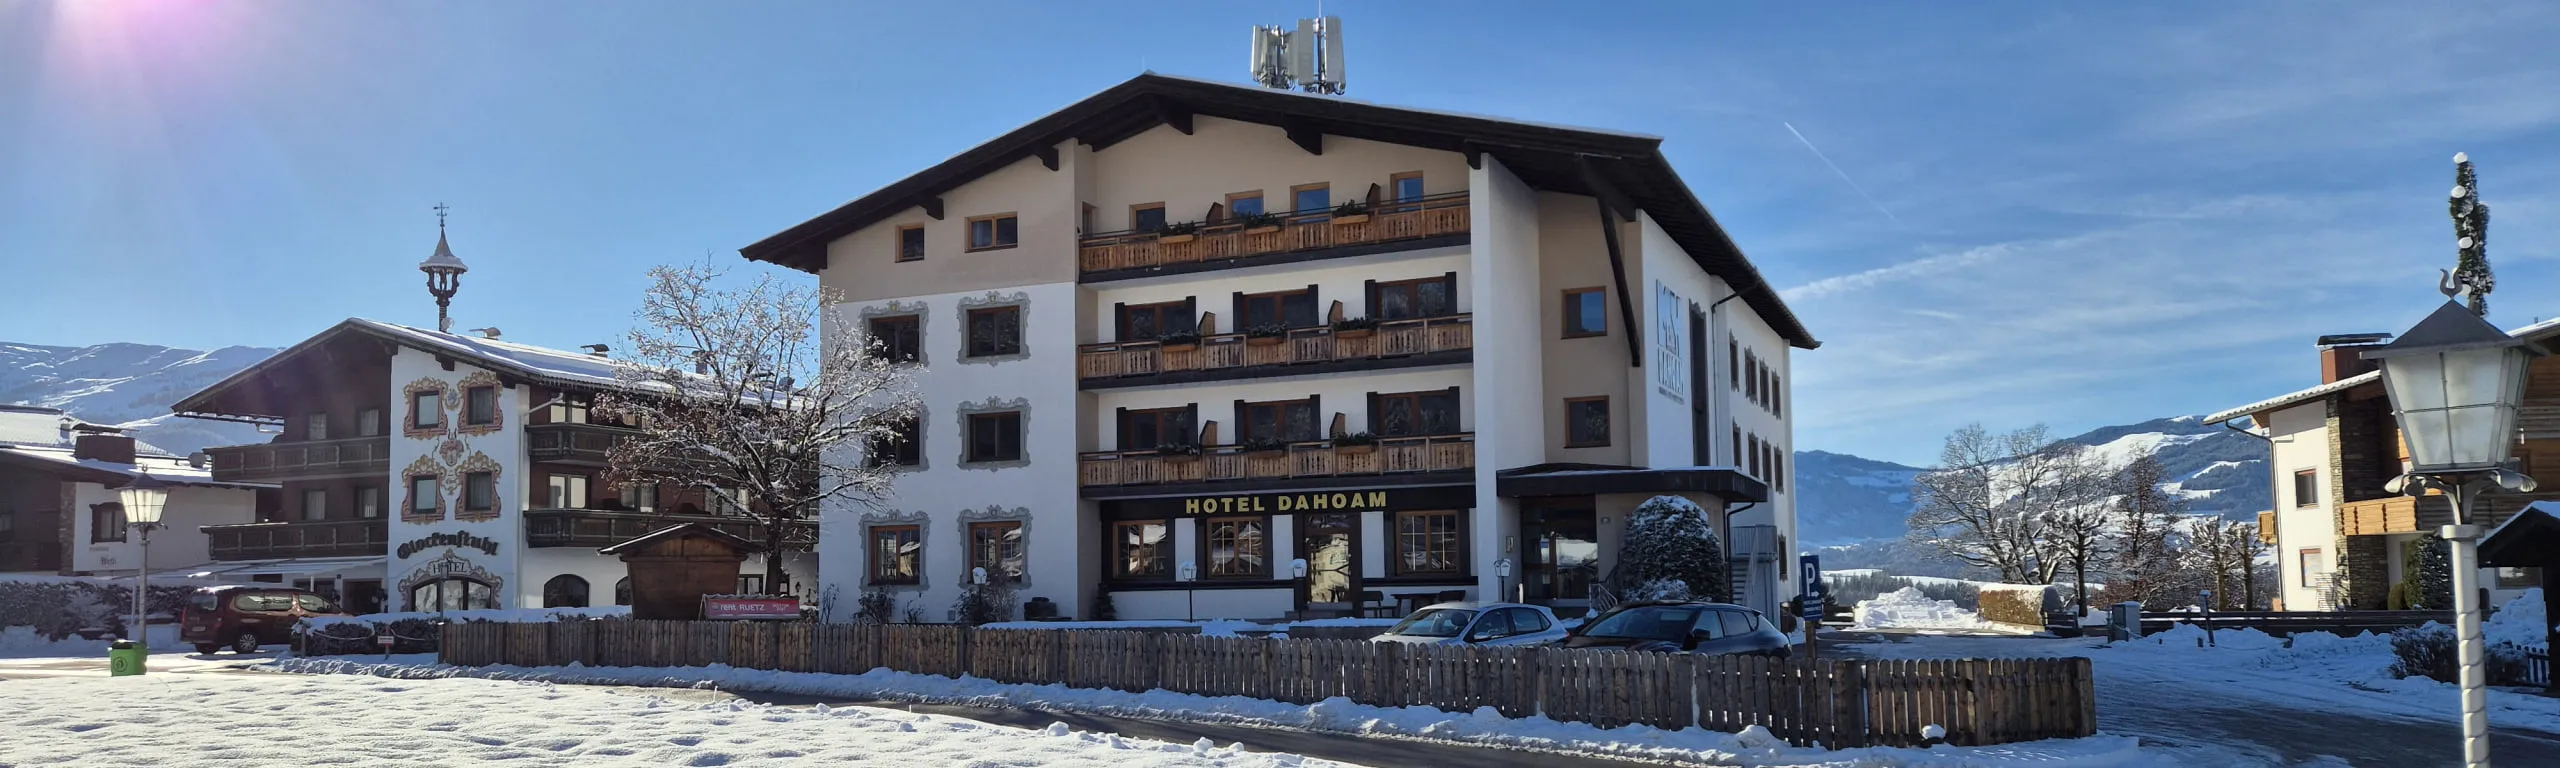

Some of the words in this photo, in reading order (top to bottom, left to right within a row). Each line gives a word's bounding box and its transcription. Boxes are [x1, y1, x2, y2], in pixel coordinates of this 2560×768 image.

[1185, 496, 1265, 514] HOTEL
[1277, 491, 1387, 511] DAHOAM
[432, 561, 468, 574] HTEL
[1805, 562, 1816, 597] P
[720, 603, 737, 611] rent
[739, 603, 765, 611] RUETZ
